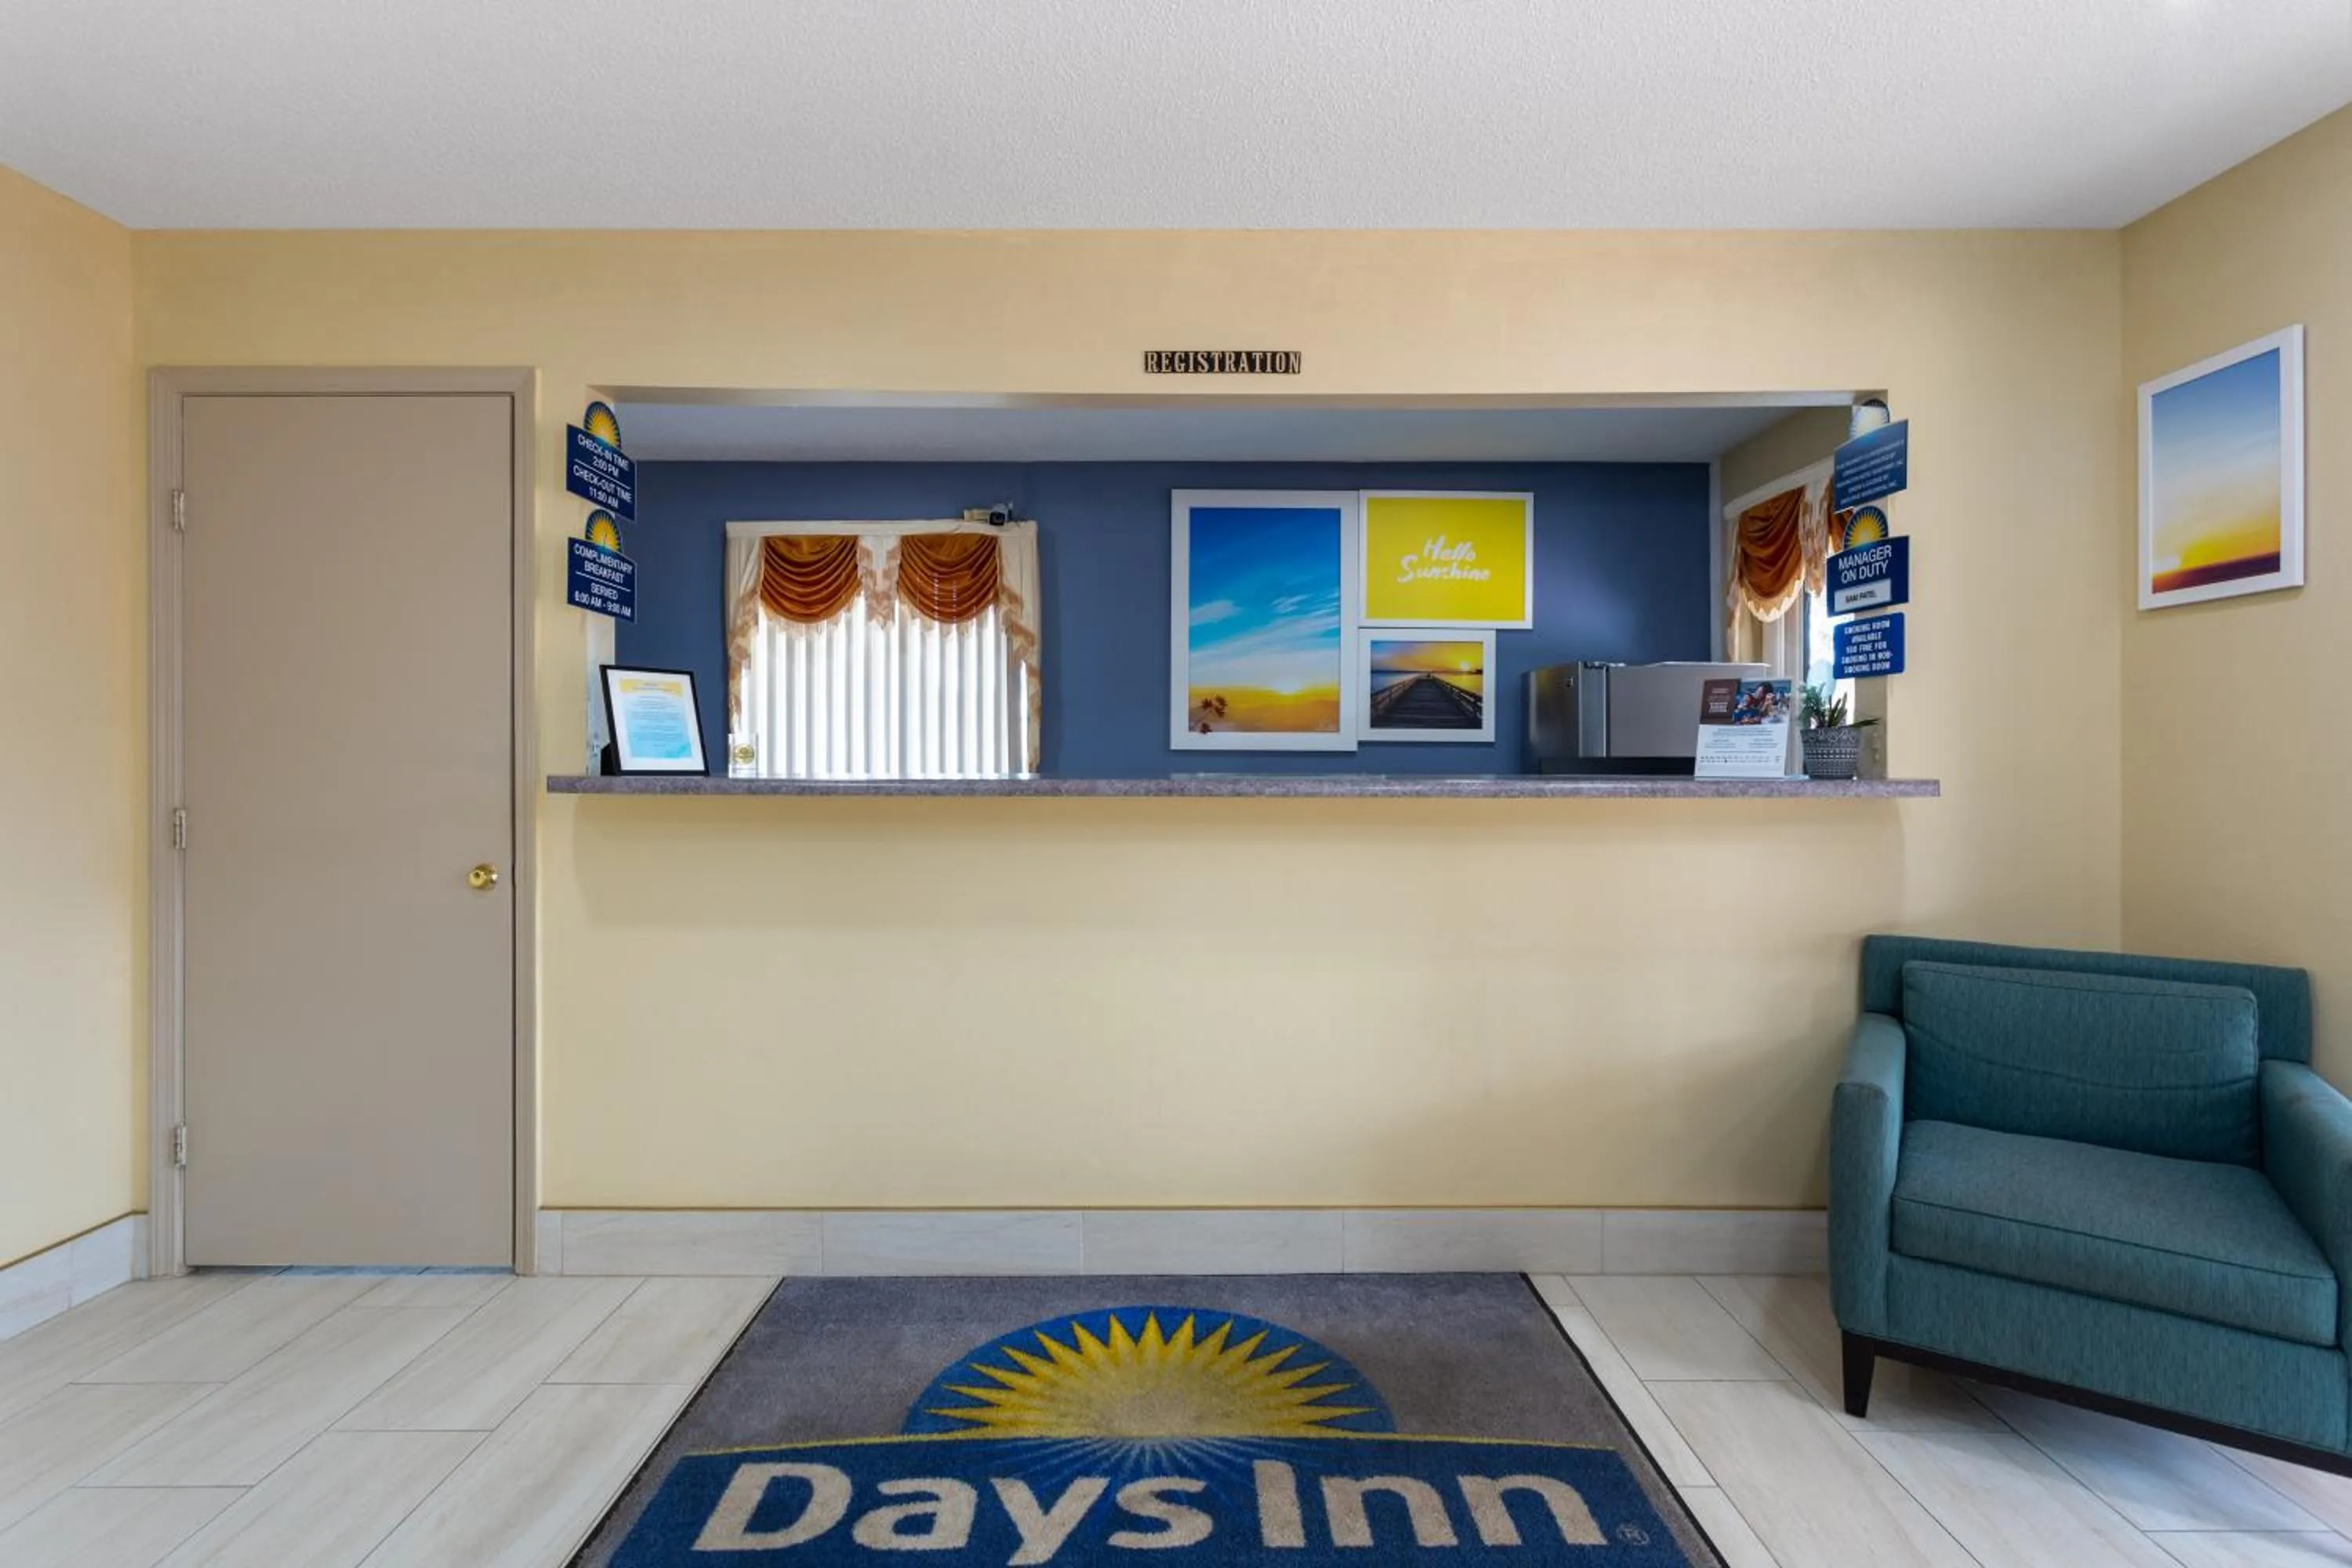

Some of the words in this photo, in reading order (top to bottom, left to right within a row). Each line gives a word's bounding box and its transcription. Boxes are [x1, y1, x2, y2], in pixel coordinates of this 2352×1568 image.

[1145, 350, 1301, 374] REGISTRATION
[578, 434, 612, 462] CHECK-IN
[613, 453, 629, 471] TIME
[608, 463, 619, 477] PM
[573, 465, 615, 495] CHECK-OUT
[616, 486, 632, 503] TIME
[608, 495, 619, 509] AM
[574, 543, 633, 575] COMPLIMENTARY
[1423, 534, 1476, 562] Hello
[1838, 545, 1892, 571] MANAGER
[584, 561, 624, 583] BREAKFAST
[1396, 554, 1490, 583] Sunshine
[1841, 568, 1857, 584] ON
[1859, 559, 1889, 579] DUTY
[590, 583, 619, 601] SERVED
[1844, 623, 1871, 634] SMOKING
[1859, 643, 1874, 653] FINE
[1843, 663, 1871, 673] SMOKING
[691, 1463, 1214, 1566] Days
[1254, 1459, 1608, 1547] Inn
